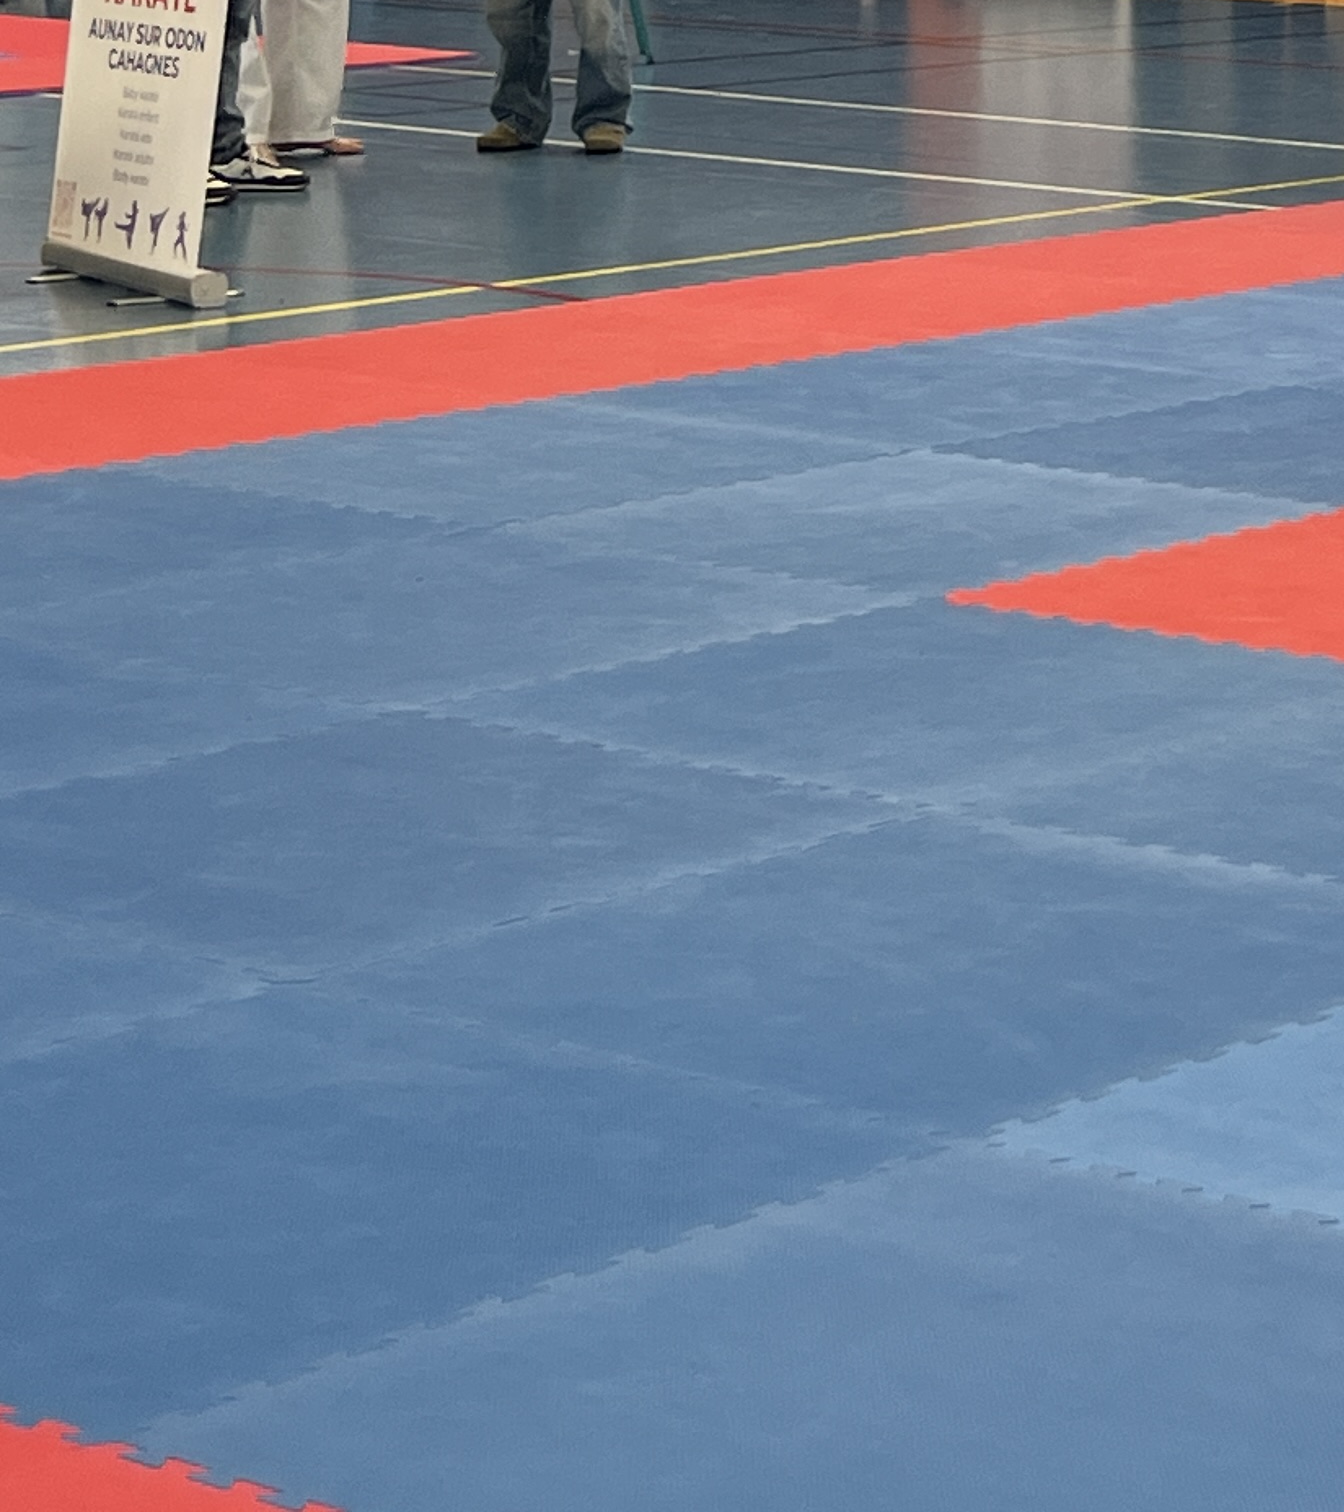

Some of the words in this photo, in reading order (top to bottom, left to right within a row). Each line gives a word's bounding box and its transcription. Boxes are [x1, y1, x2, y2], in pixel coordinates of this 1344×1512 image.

[88, 17, 135, 43] AUNAY
[135, 23, 162, 47] SUR
[164, 27, 208, 53] ODON
